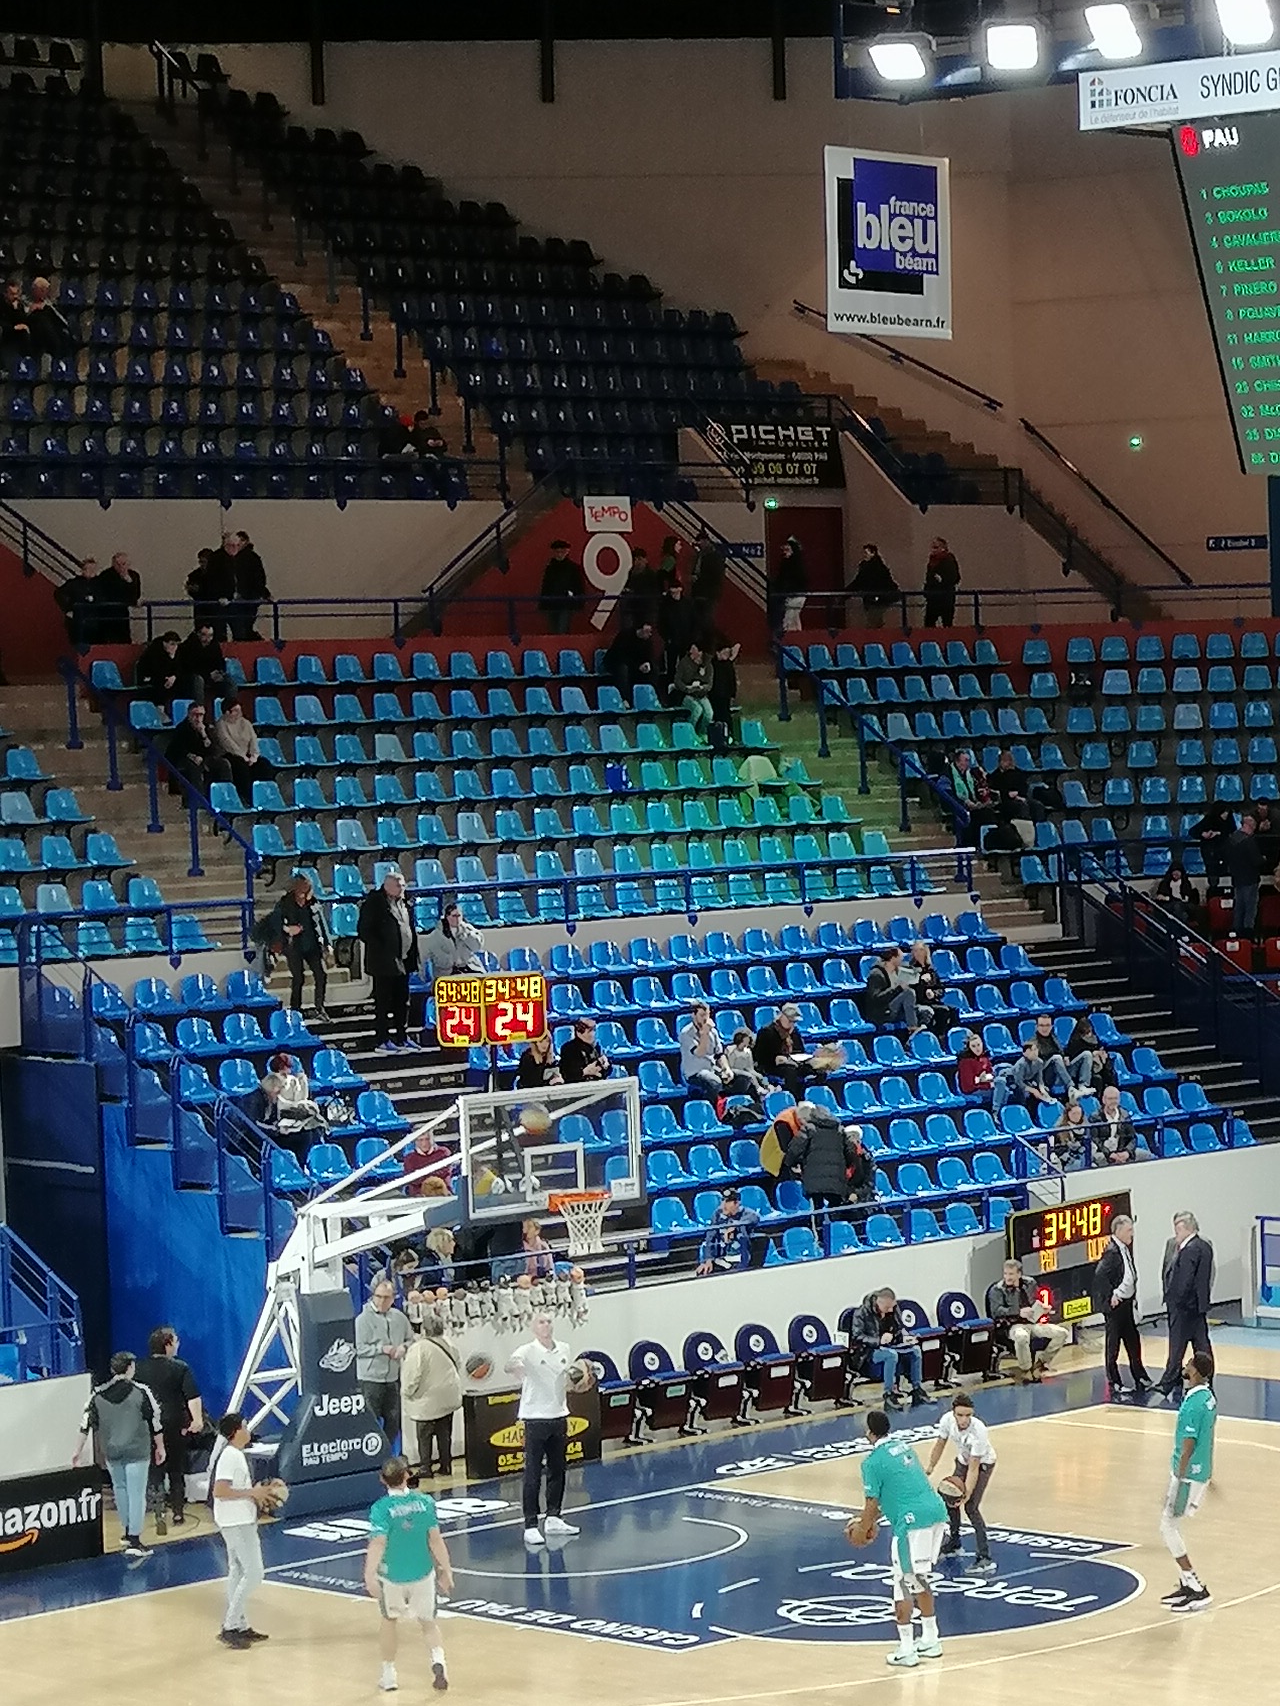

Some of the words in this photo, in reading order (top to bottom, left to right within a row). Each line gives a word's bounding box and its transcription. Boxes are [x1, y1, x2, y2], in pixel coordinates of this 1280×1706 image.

[1114, 83, 1178, 106] FONCIA
[1200, 69, 1261, 99] SYNDIC
[1202, 127, 1239, 149] PAU
[889, 195, 935, 217] france
[856, 201, 936, 254] bleu
[1228, 256, 1276, 272] KELLER
[833, 312, 947, 329] www.bleubearn.fr
[731, 424, 831, 443] PICHET
[587, 505, 629, 523] TEMPO
[583, 532, 633, 631] 9
[485, 975, 543, 1002] 34:48
[446, 1006, 475, 1039] 24
[495, 1001, 535, 1037] 24
[1043, 1202, 1102, 1248] 34:48
[314, 1393, 366, 1418] Jeep
[447, 1597, 519, 1620] PAU
[520, 1609, 566, 1626] DE
[569, 1618, 701, 1646] CASINO
